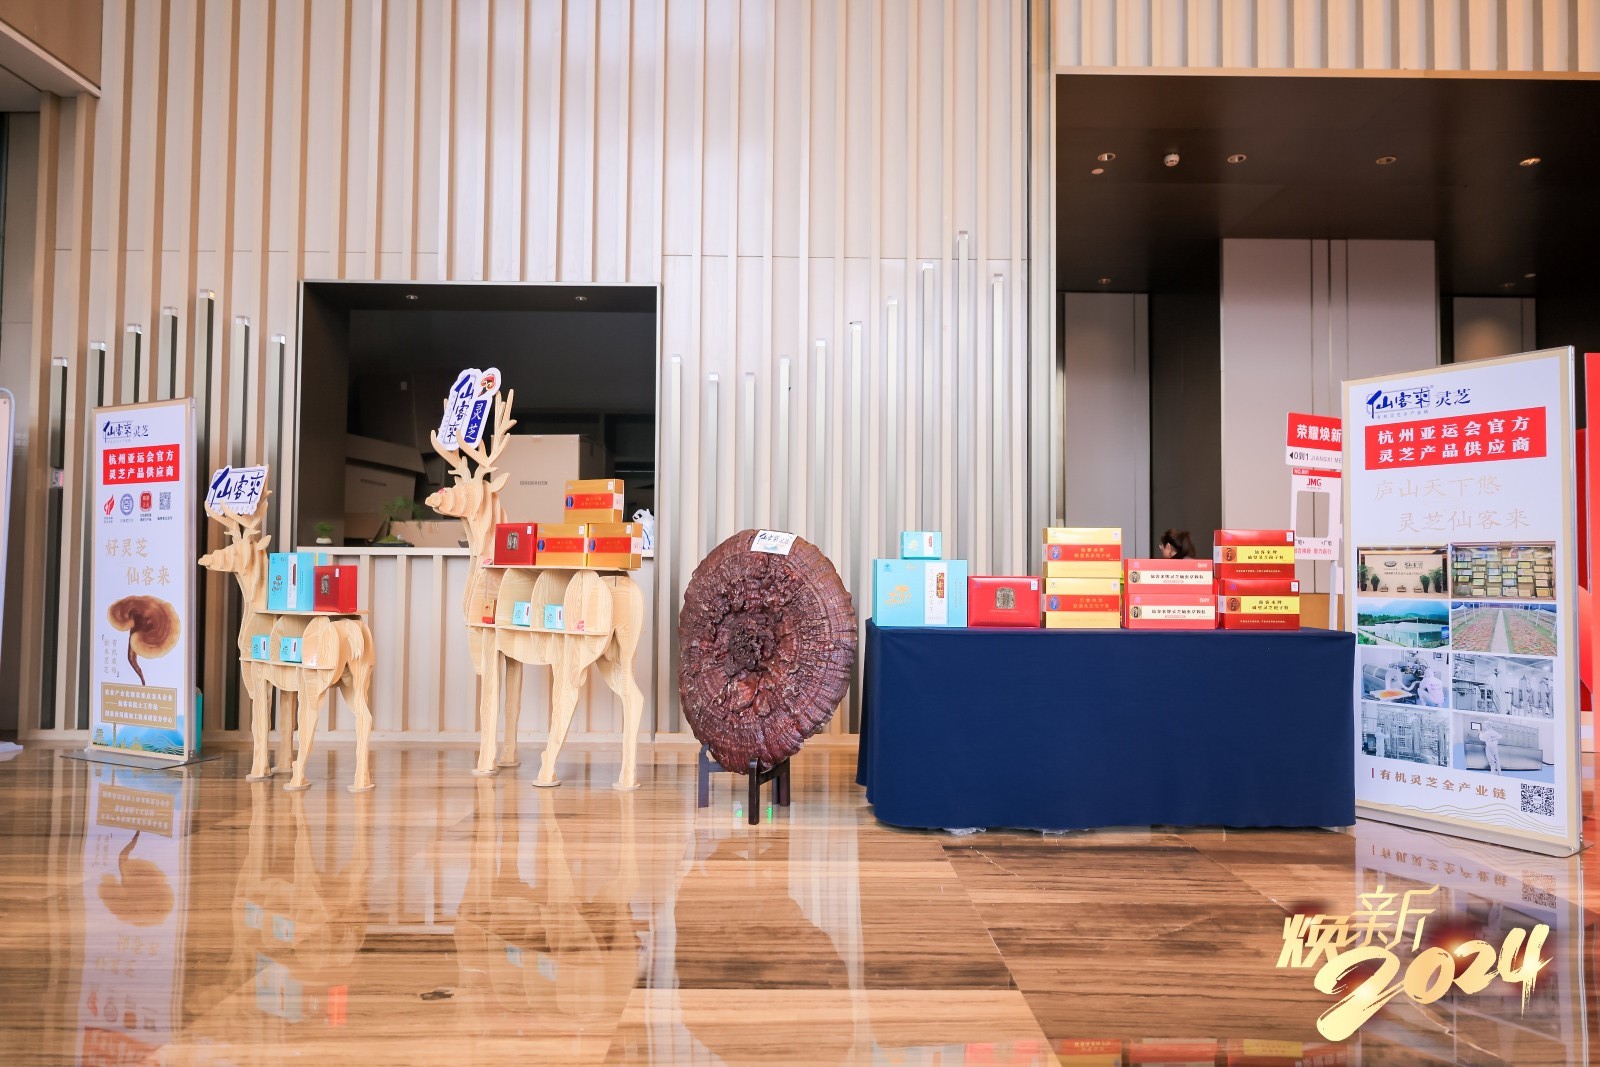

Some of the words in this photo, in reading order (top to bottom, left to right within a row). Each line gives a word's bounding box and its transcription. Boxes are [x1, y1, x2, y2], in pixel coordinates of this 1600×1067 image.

[465, 402, 484, 440] 灵芝
[1378, 415, 1531, 445] 杭州亚运会官方
[1296, 423, 1342, 443] 荣耀焕新
[108, 449, 174, 465] 杭州亚运会官方
[1311, 455, 1333, 463] JIANGXI
[1378, 436, 1531, 464] 灵芝产品供应商
[108, 465, 174, 480] 灵芝产品供应商
[1307, 478, 1322, 486] JMG
[210, 467, 264, 508] 仙客来
[1374, 474, 1504, 501] 庐山天下悠
[1397, 508, 1531, 534] 灵芝仙客来
[105, 537, 148, 558] 好灵芝
[127, 565, 171, 586] 仙客来
[1380, 768, 1507, 800] 有机灵芝全产业链
